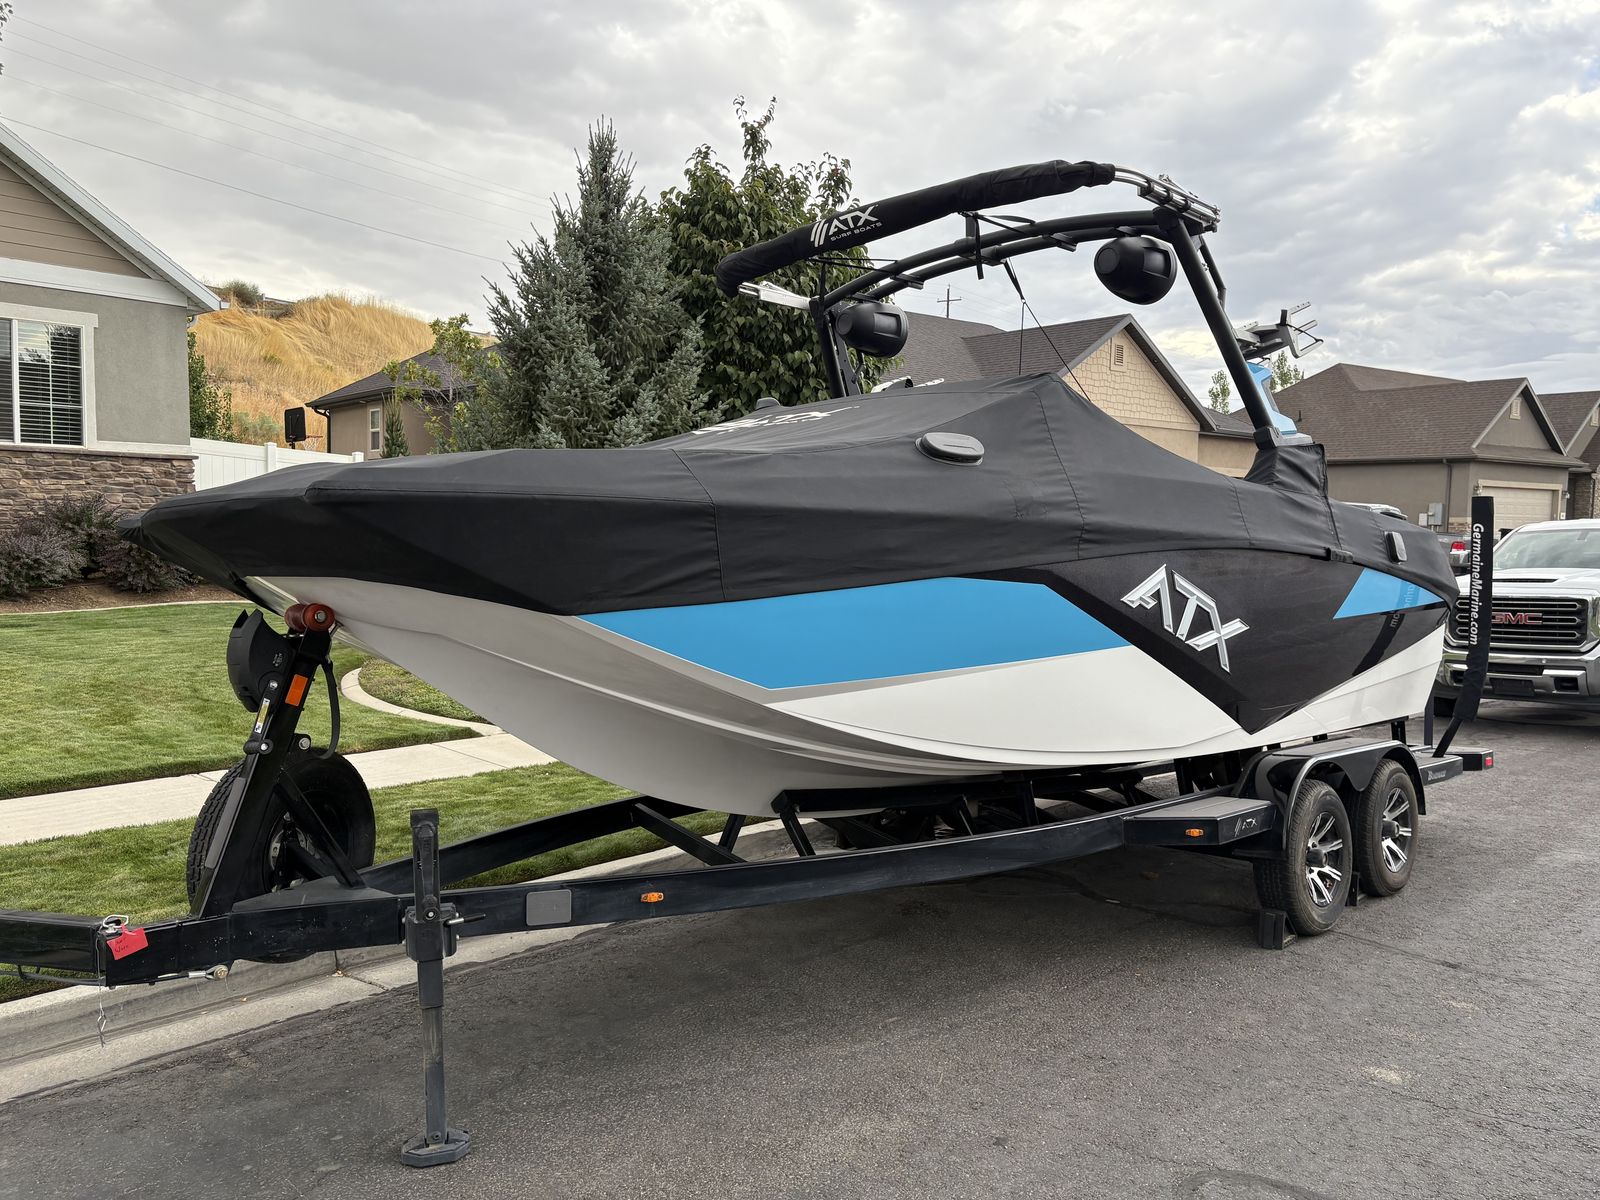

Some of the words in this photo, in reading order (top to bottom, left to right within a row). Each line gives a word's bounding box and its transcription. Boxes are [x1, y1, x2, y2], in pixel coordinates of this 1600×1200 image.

[830, 230, 852, 242] SURF
[853, 221, 883, 235] BOATS
[1469, 523, 1485, 645] GermaineMarine.com
[1120, 563, 1251, 674] ATX
[1491, 611, 1543, 625] GMC
